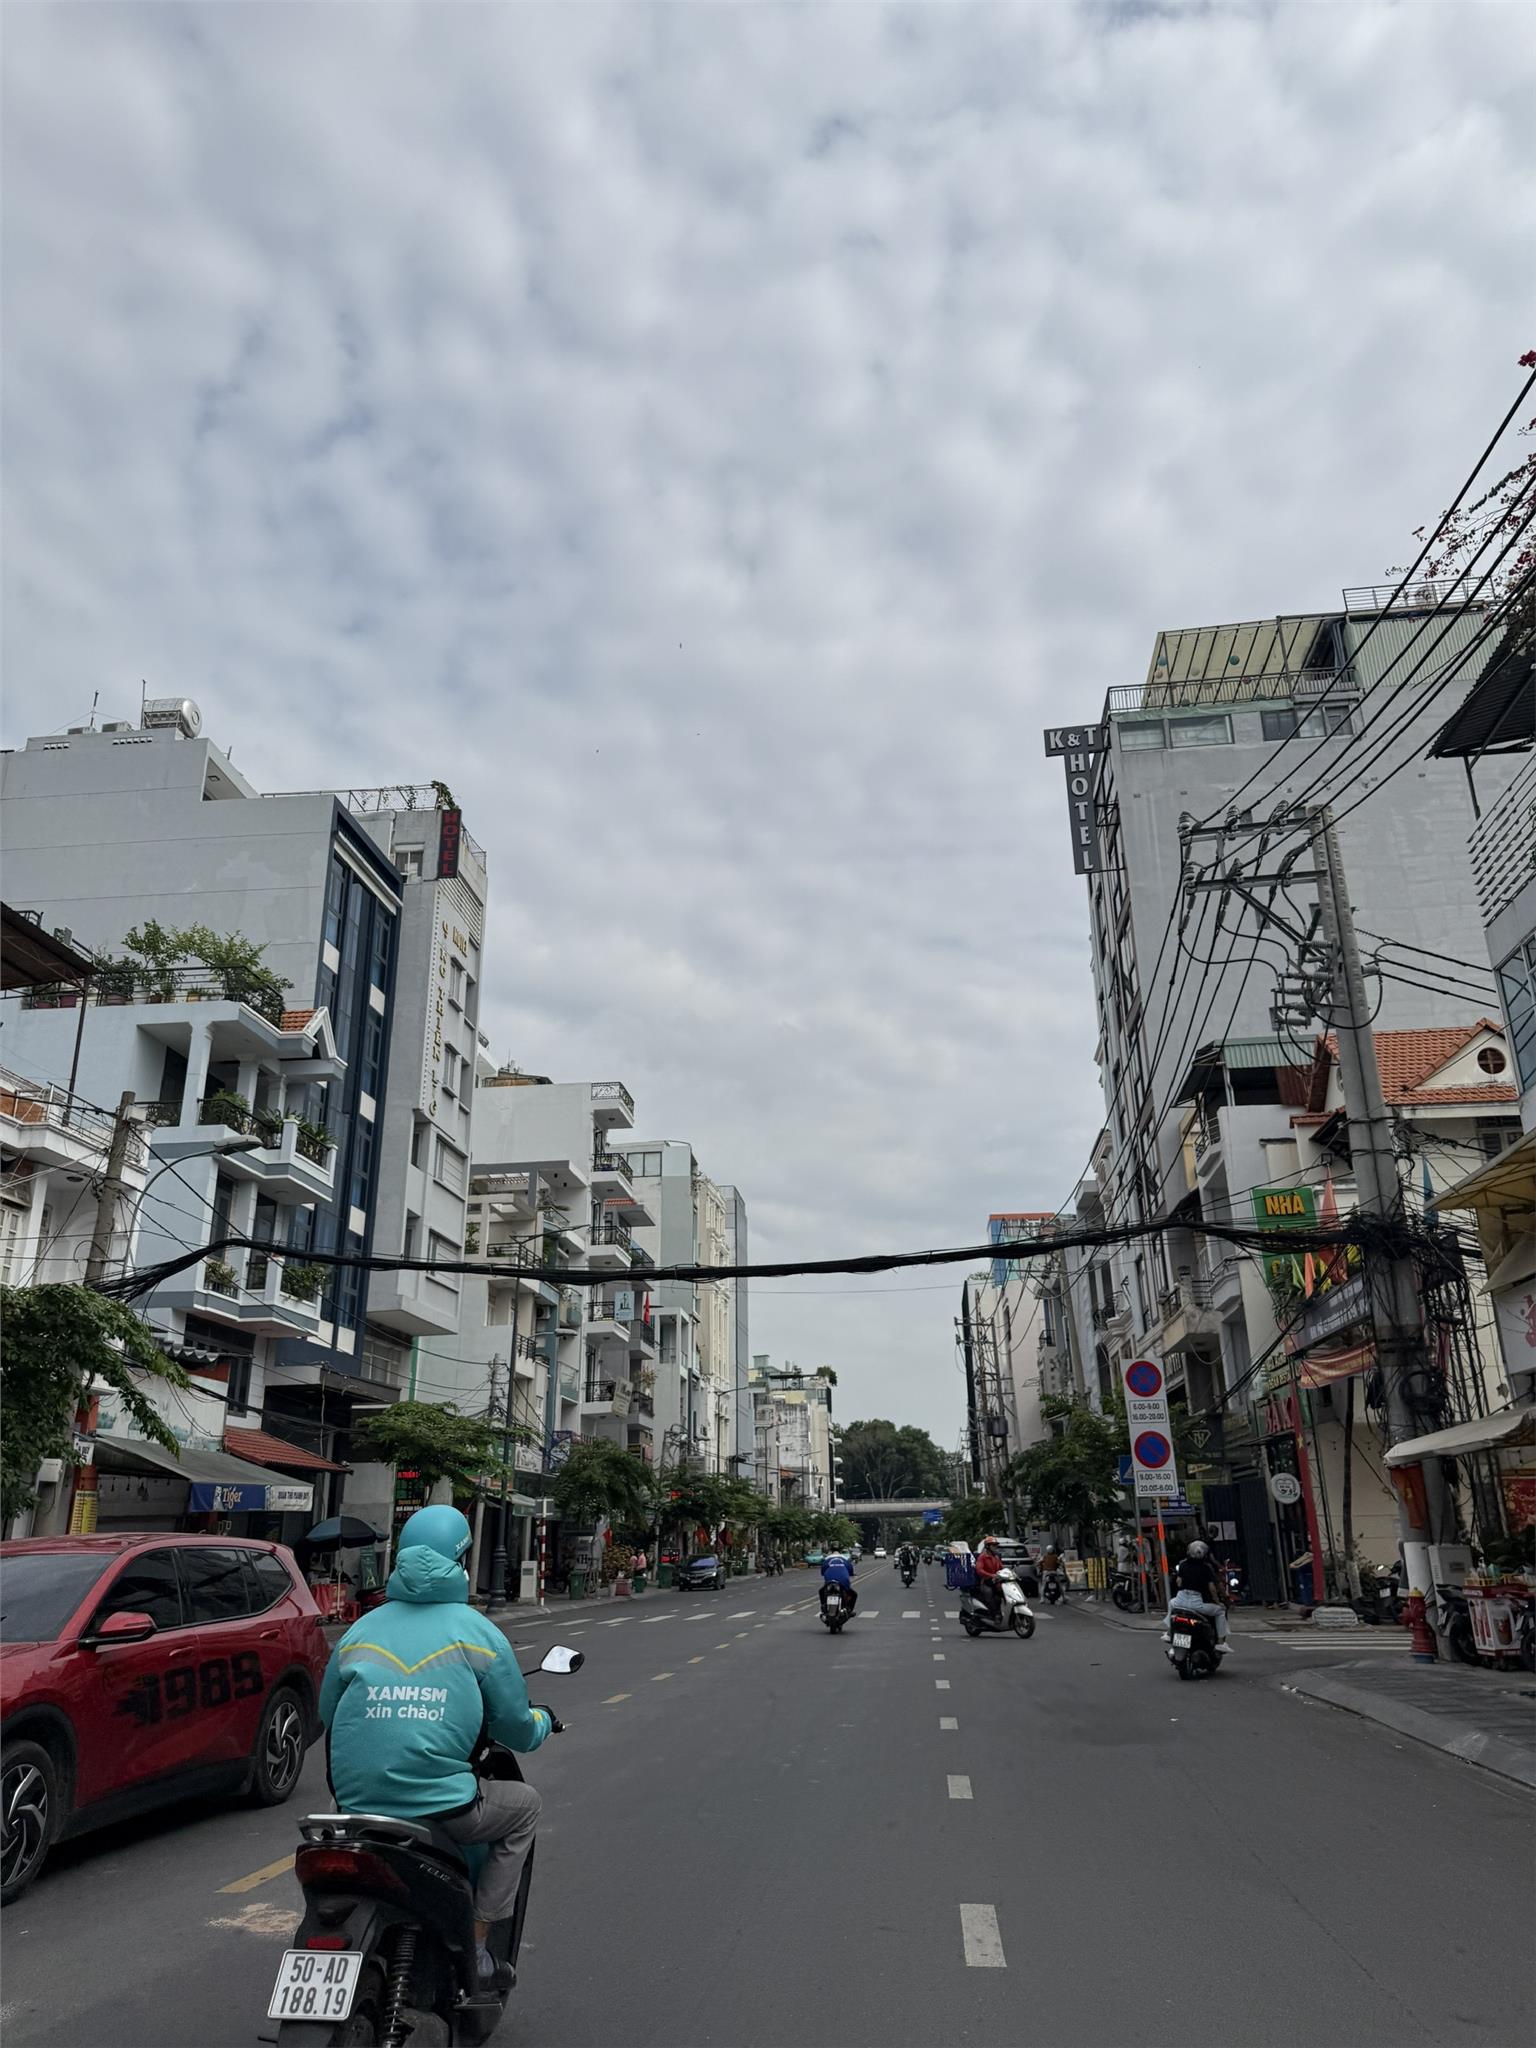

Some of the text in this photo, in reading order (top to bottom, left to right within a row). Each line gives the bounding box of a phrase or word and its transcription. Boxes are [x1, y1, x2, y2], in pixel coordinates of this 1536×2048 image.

[1070, 753, 1094, 870] HOTEL
[442, 811, 458, 874] HOTEL
[1264, 1191, 1305, 1215] NHÀ
[222, 1486, 243, 1509] Tiger
[120, 1650, 265, 1724] 1989
[365, 1703, 445, 1721] xin chào!
[290, 1956, 349, 1984] 50-AD
[280, 1986, 347, 2015] 188.19
